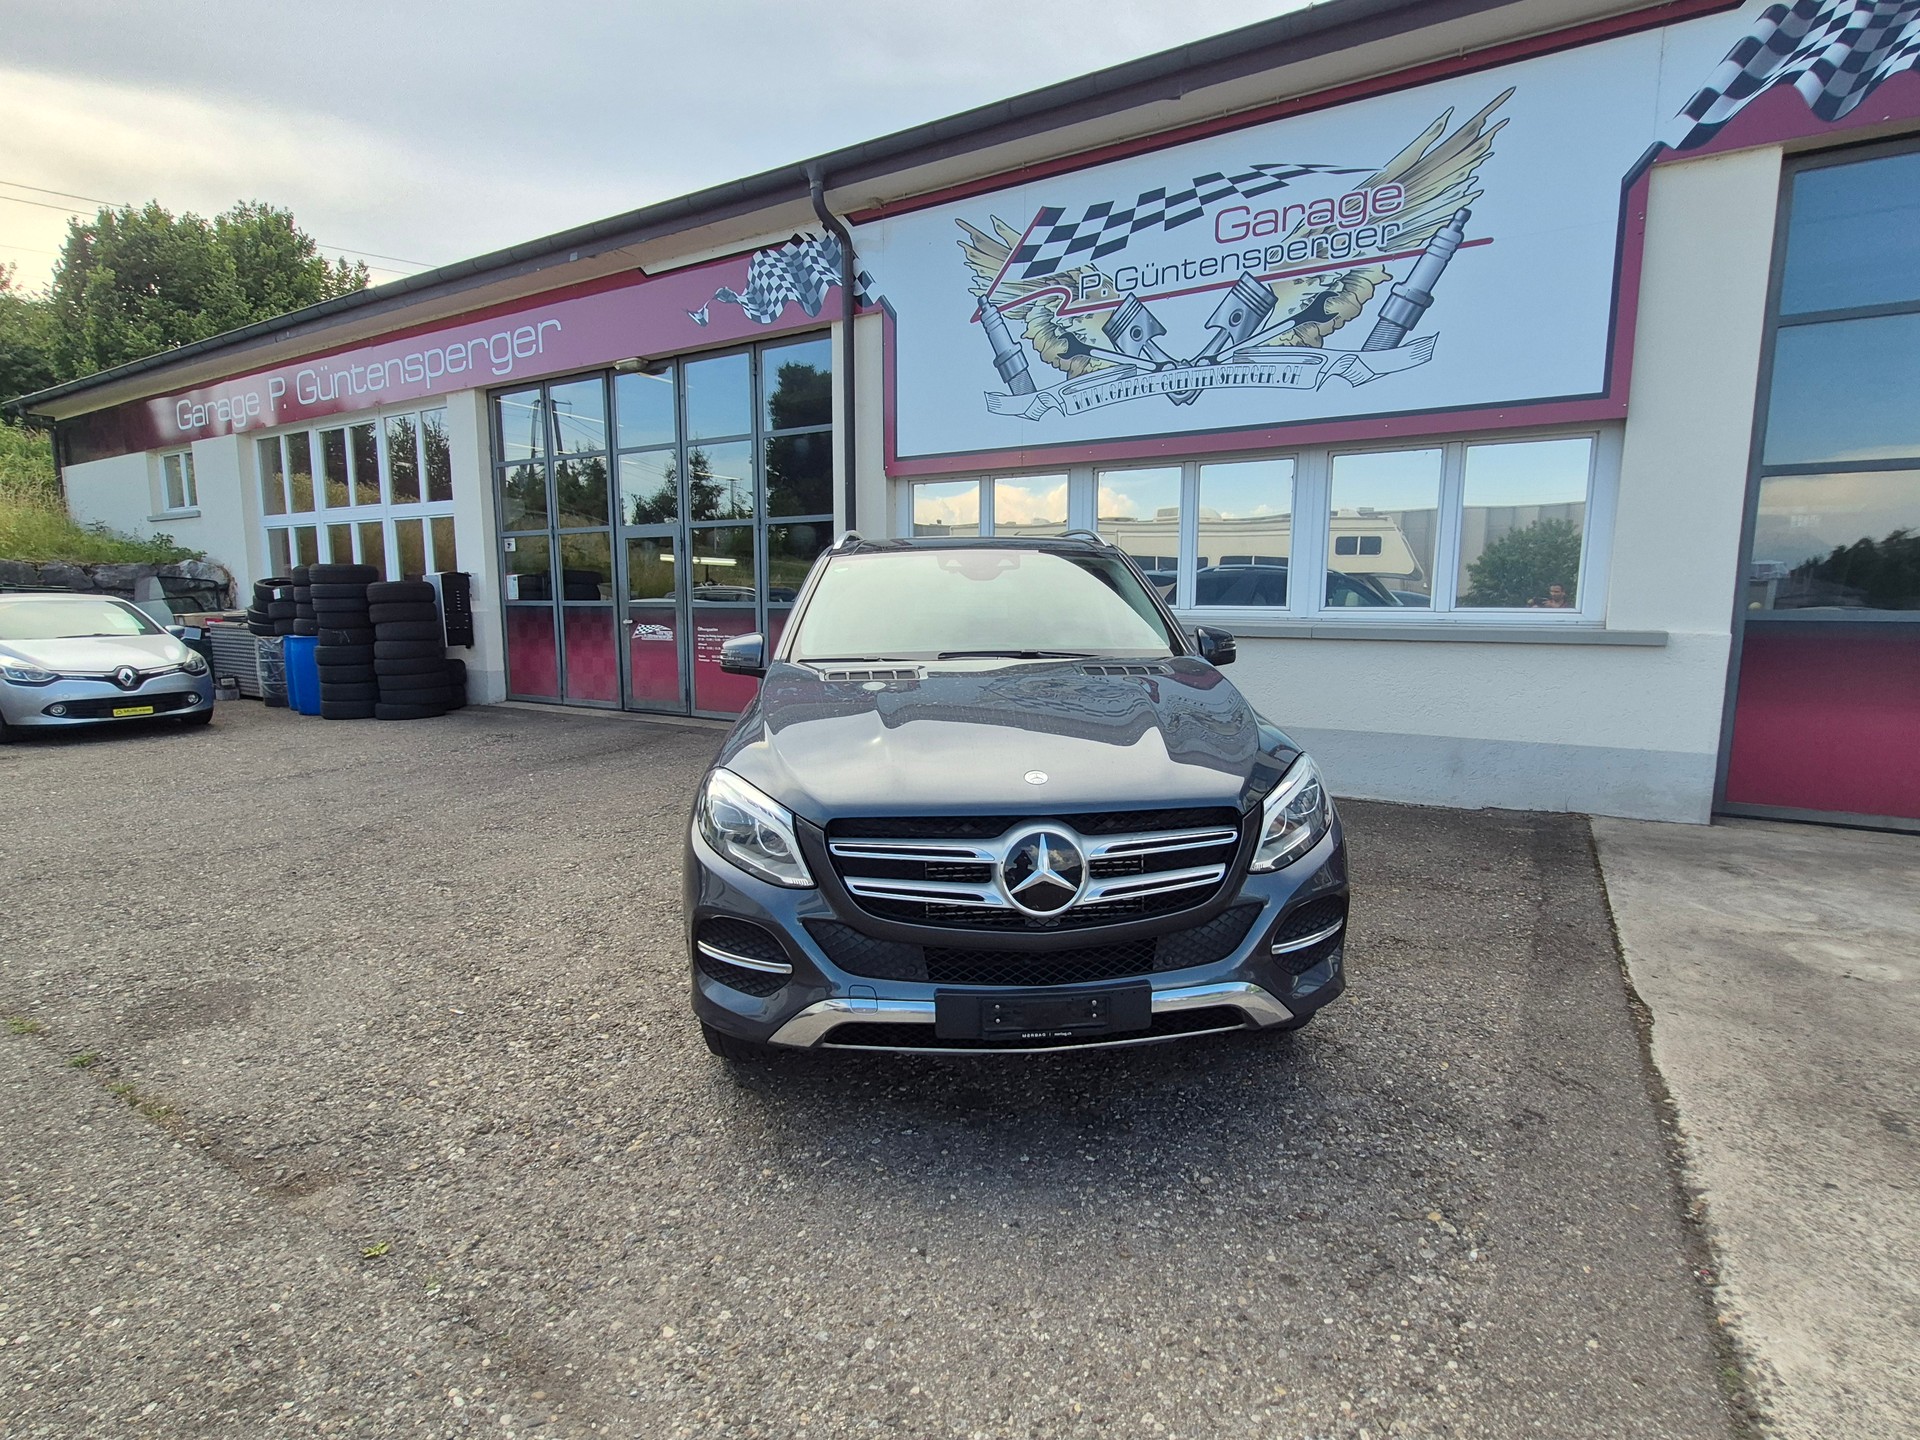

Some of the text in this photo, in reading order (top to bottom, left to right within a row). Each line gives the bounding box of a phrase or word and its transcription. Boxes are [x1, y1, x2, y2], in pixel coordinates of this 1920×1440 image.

[1214, 185, 1402, 244] Garage
[1079, 222, 1401, 299] P. Güntensperger
[175, 318, 562, 430] Garage P. Güntensperger
